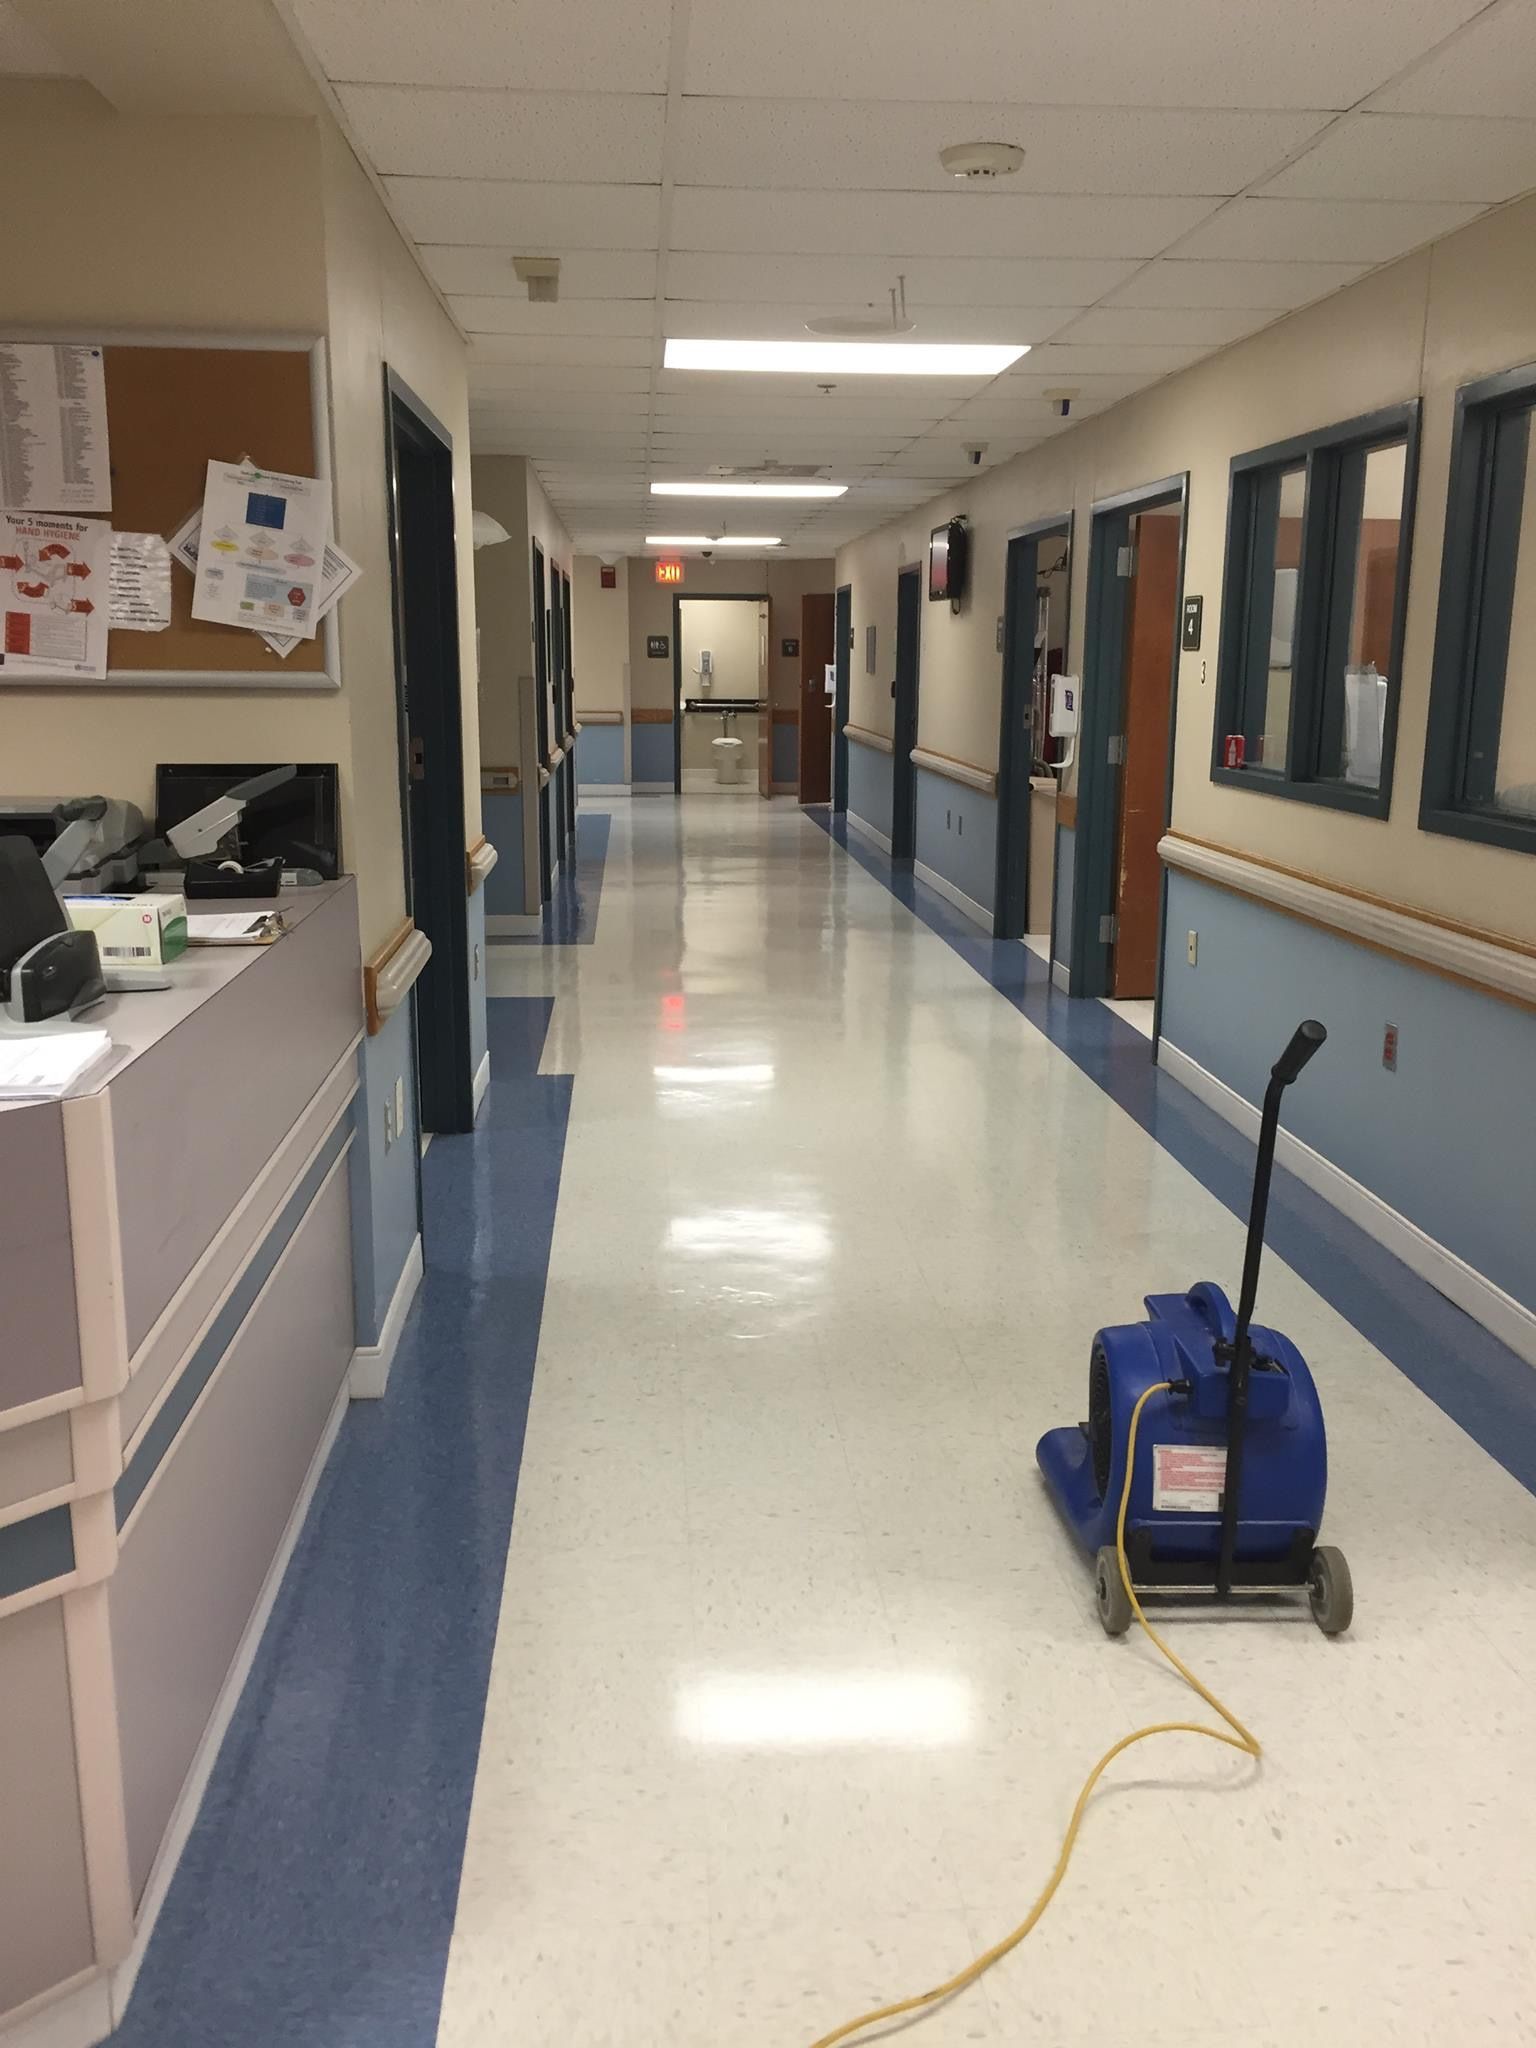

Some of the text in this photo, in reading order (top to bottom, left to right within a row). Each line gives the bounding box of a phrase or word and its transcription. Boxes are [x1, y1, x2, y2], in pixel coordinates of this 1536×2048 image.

[6, 515, 88, 532] Your 5 moments for
[16, 526, 80, 541] HAND HYGIENE
[658, 564, 681, 581] EXIT
[1186, 604, 1198, 613] ROOM
[1188, 618, 1194, 635] 4
